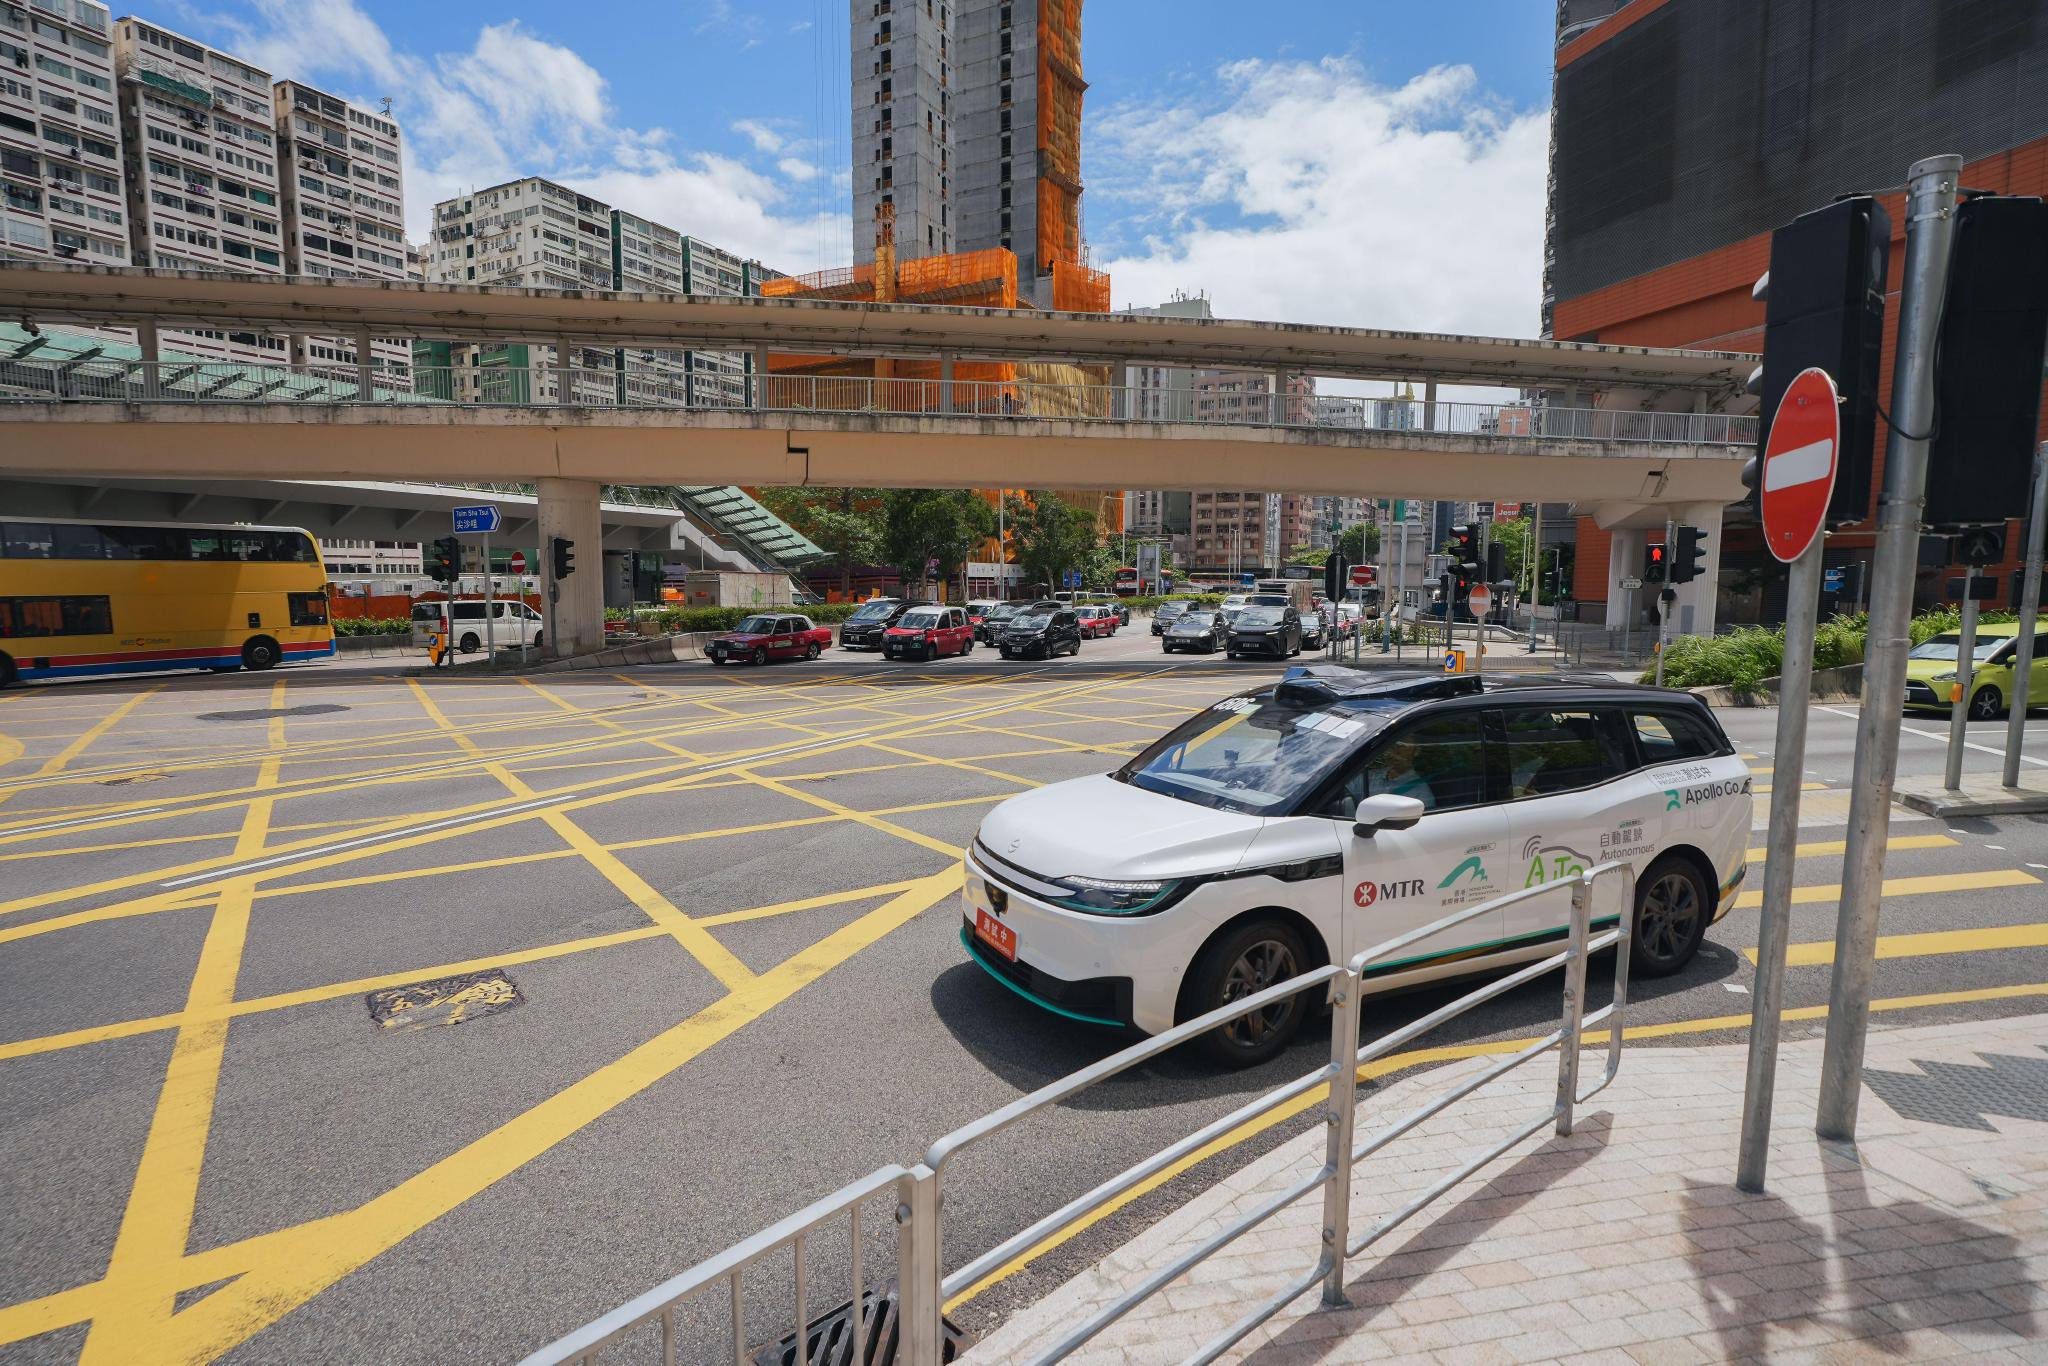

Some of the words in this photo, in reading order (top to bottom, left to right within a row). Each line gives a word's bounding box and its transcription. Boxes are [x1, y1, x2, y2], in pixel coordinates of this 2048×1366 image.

[1685, 783, 1723, 805] Apollo
[1724, 781, 1739, 796] Go
[1599, 843, 1655, 861] Autonomous
[1380, 879, 1425, 901] MTR
